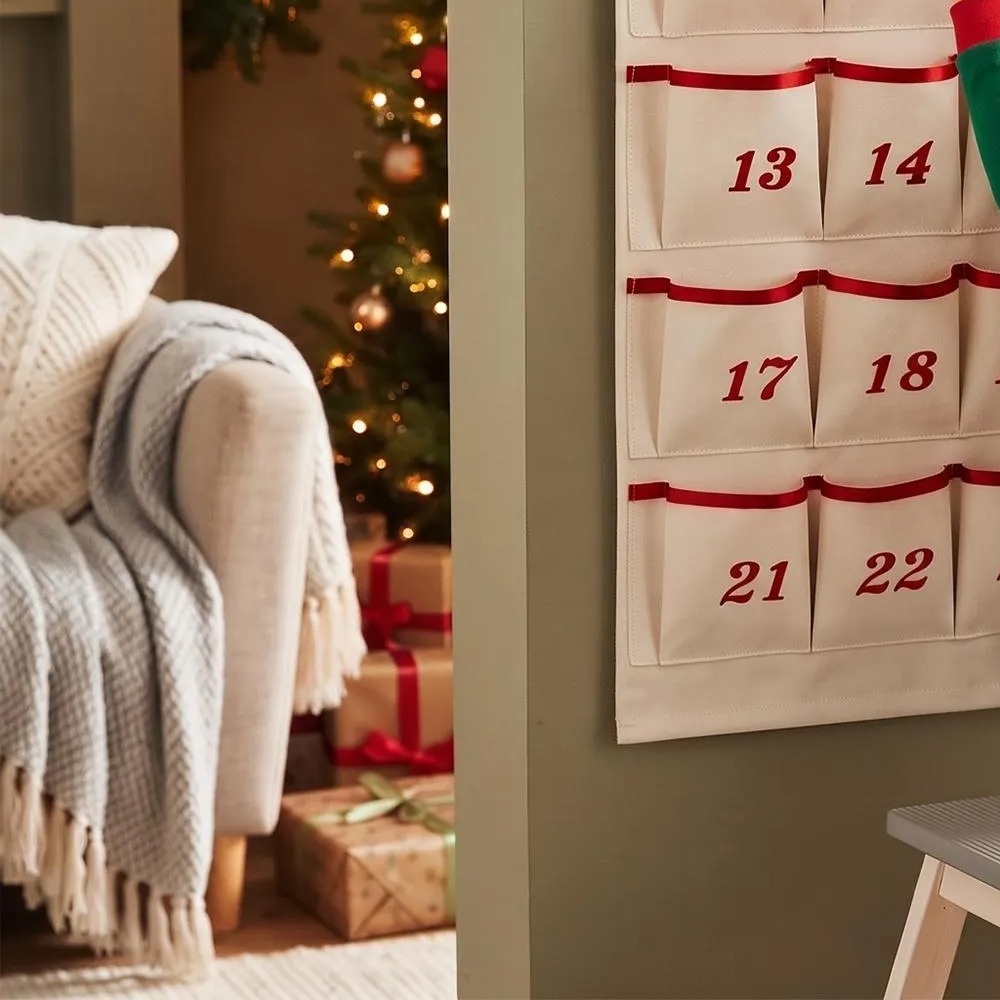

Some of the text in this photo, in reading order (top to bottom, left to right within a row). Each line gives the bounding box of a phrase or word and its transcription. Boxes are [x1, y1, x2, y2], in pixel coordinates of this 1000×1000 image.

[729, 147, 796, 192] 13
[865, 141, 933, 185] 14
[722, 356, 798, 401] 17
[865, 351, 937, 394] 18
[720, 561, 788, 605] 21
[856, 548, 934, 596] 22
